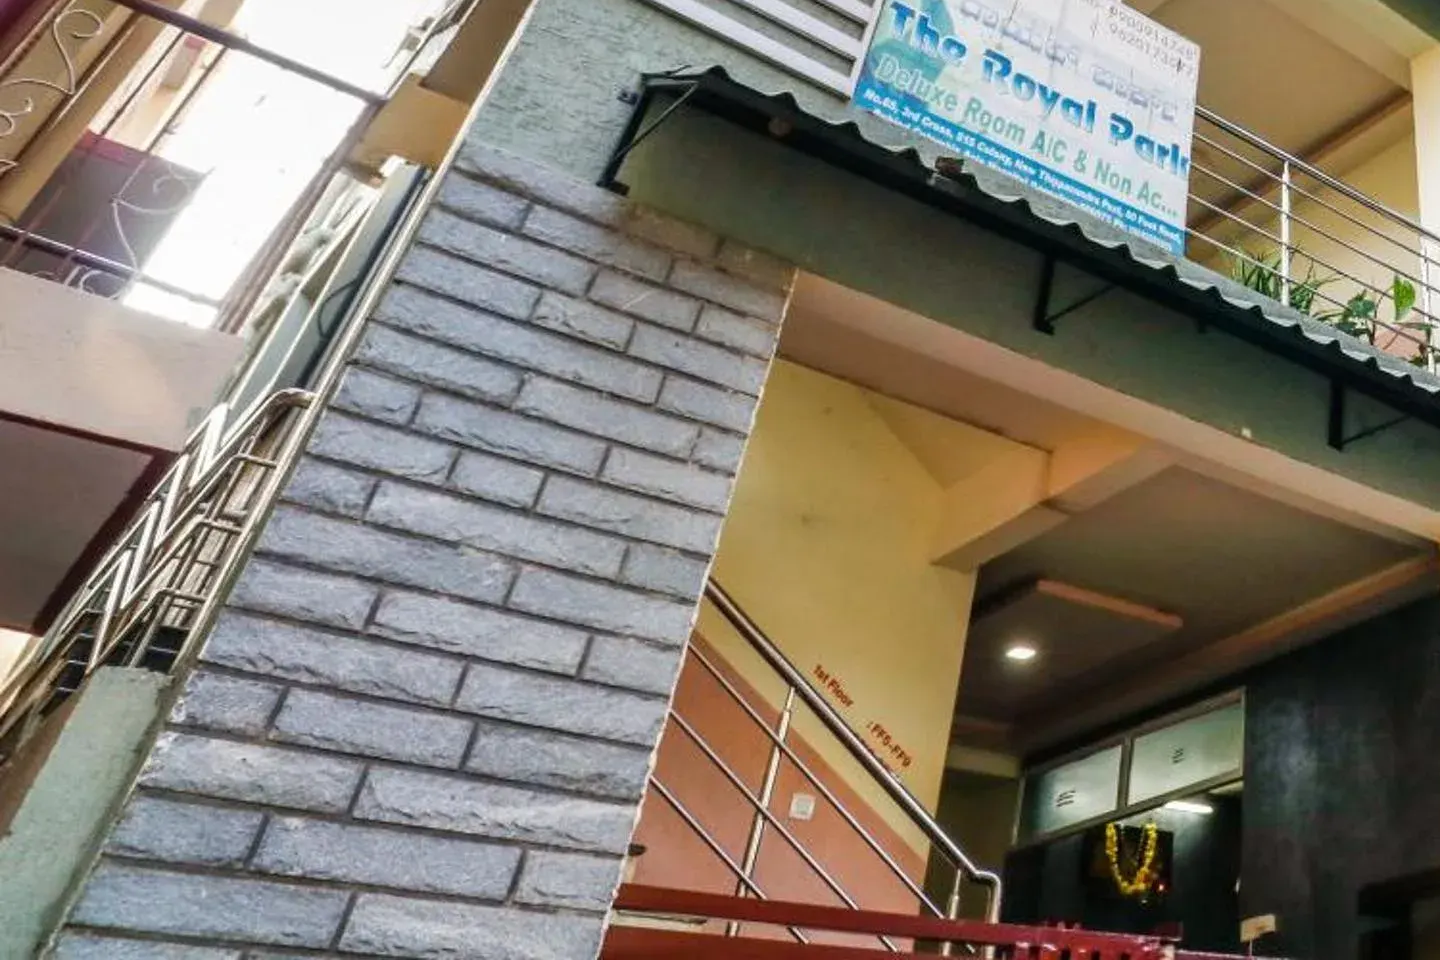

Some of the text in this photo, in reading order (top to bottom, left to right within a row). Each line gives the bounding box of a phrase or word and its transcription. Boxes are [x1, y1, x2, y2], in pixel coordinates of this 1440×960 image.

[877, 53, 958, 113] Deluxe
[962, 95, 1026, 144] Room
[1073, 147, 1087, 174] &
[1095, 159, 1132, 196] Non
[890, 0, 967, 62] The
[981, 47, 1098, 135] Royal
